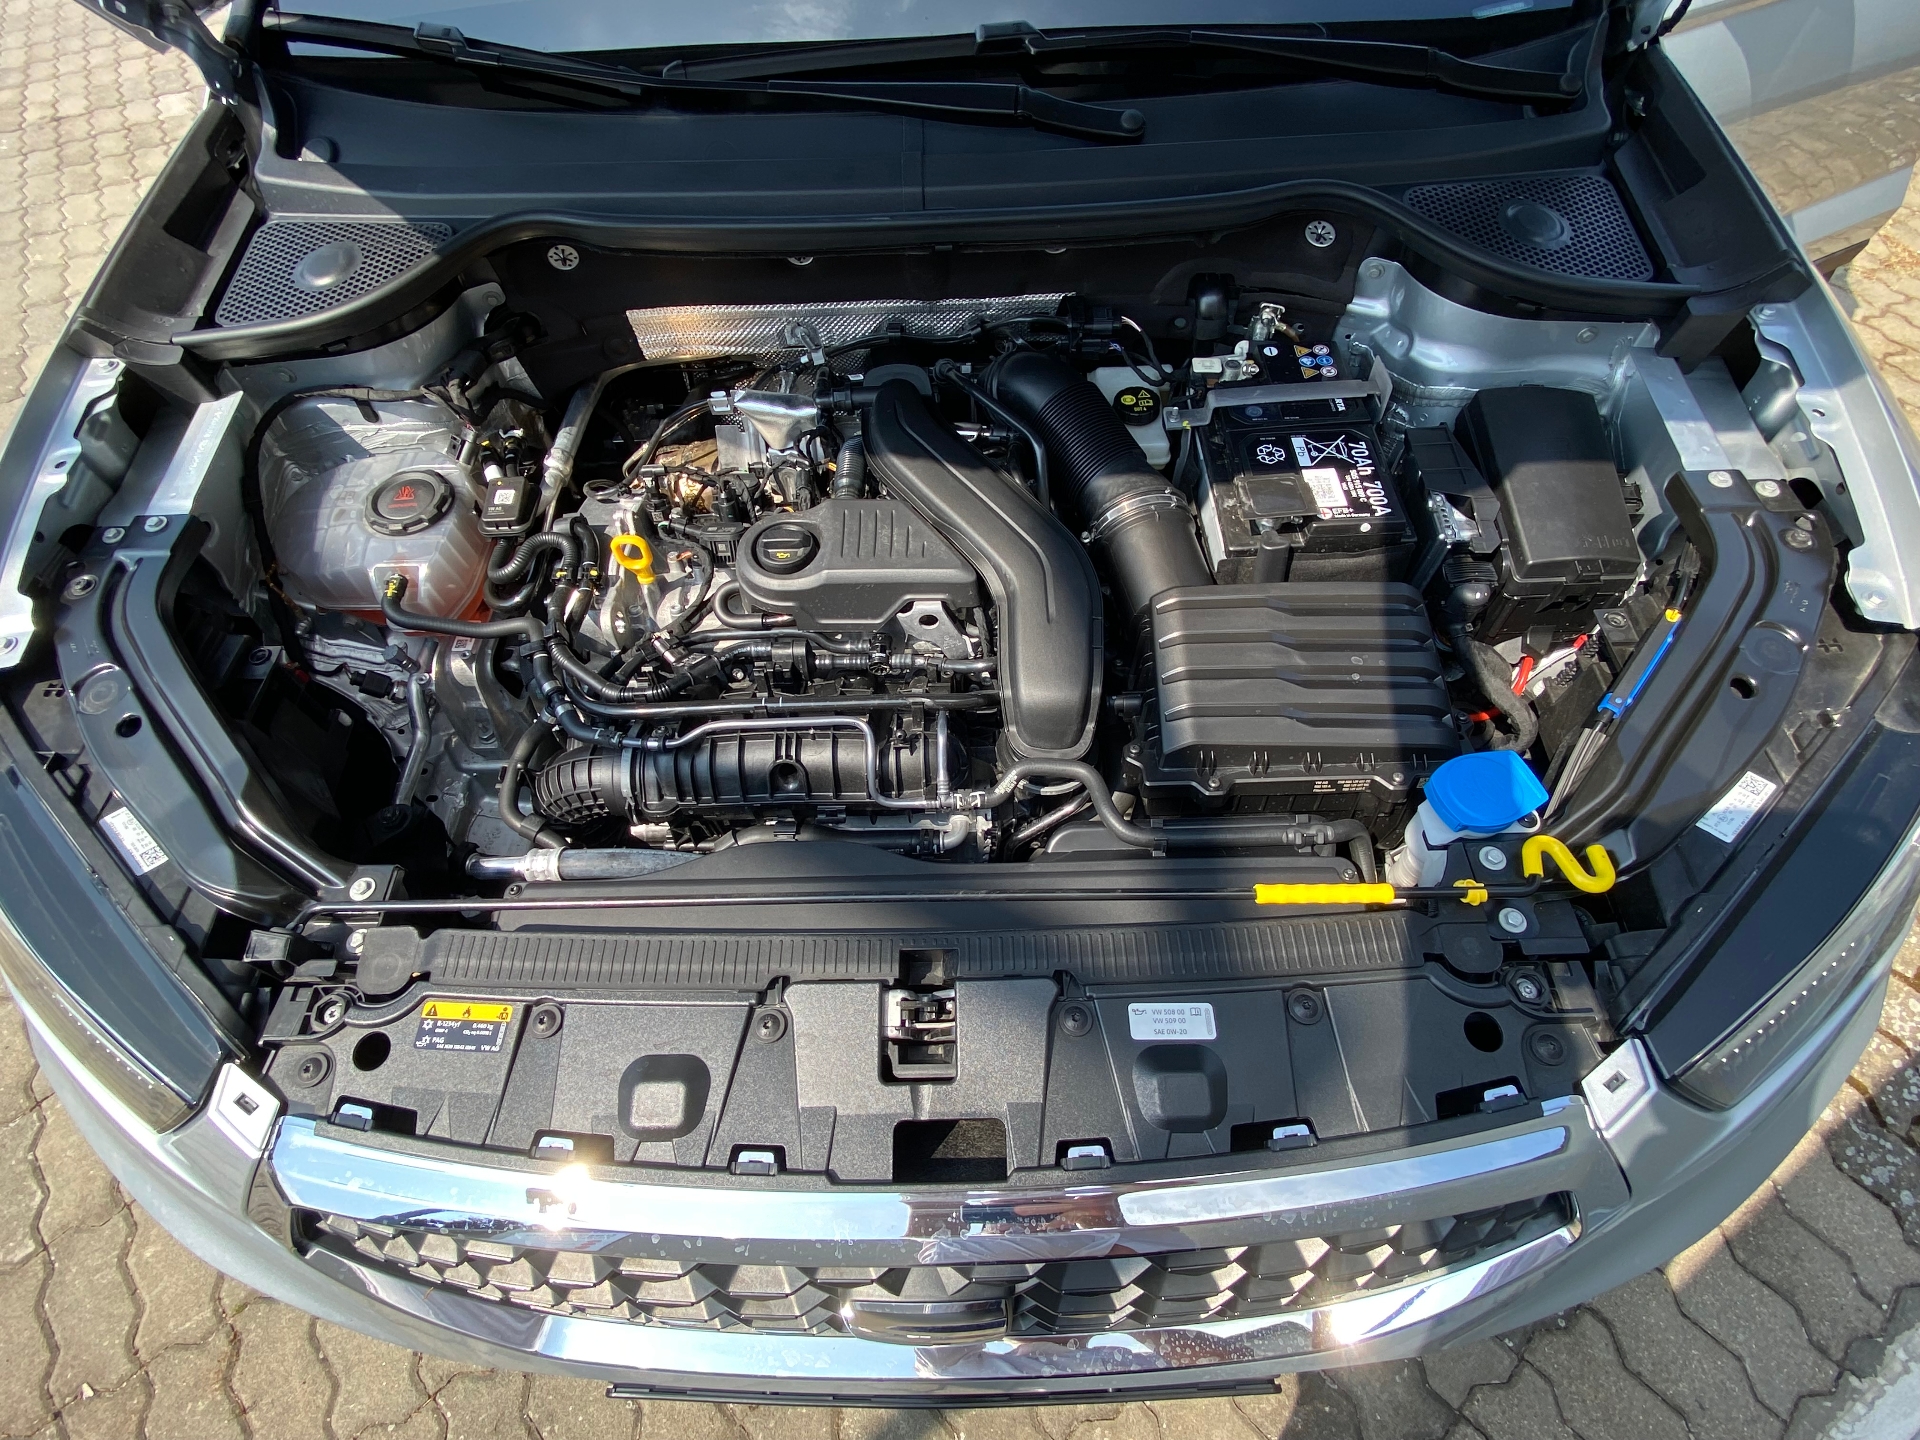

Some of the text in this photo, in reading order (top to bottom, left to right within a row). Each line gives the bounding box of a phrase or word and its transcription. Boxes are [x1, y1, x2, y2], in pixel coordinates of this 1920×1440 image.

[1295, 446, 1306, 457] Pb
[1348, 441, 1392, 517] 70Ah 700A
